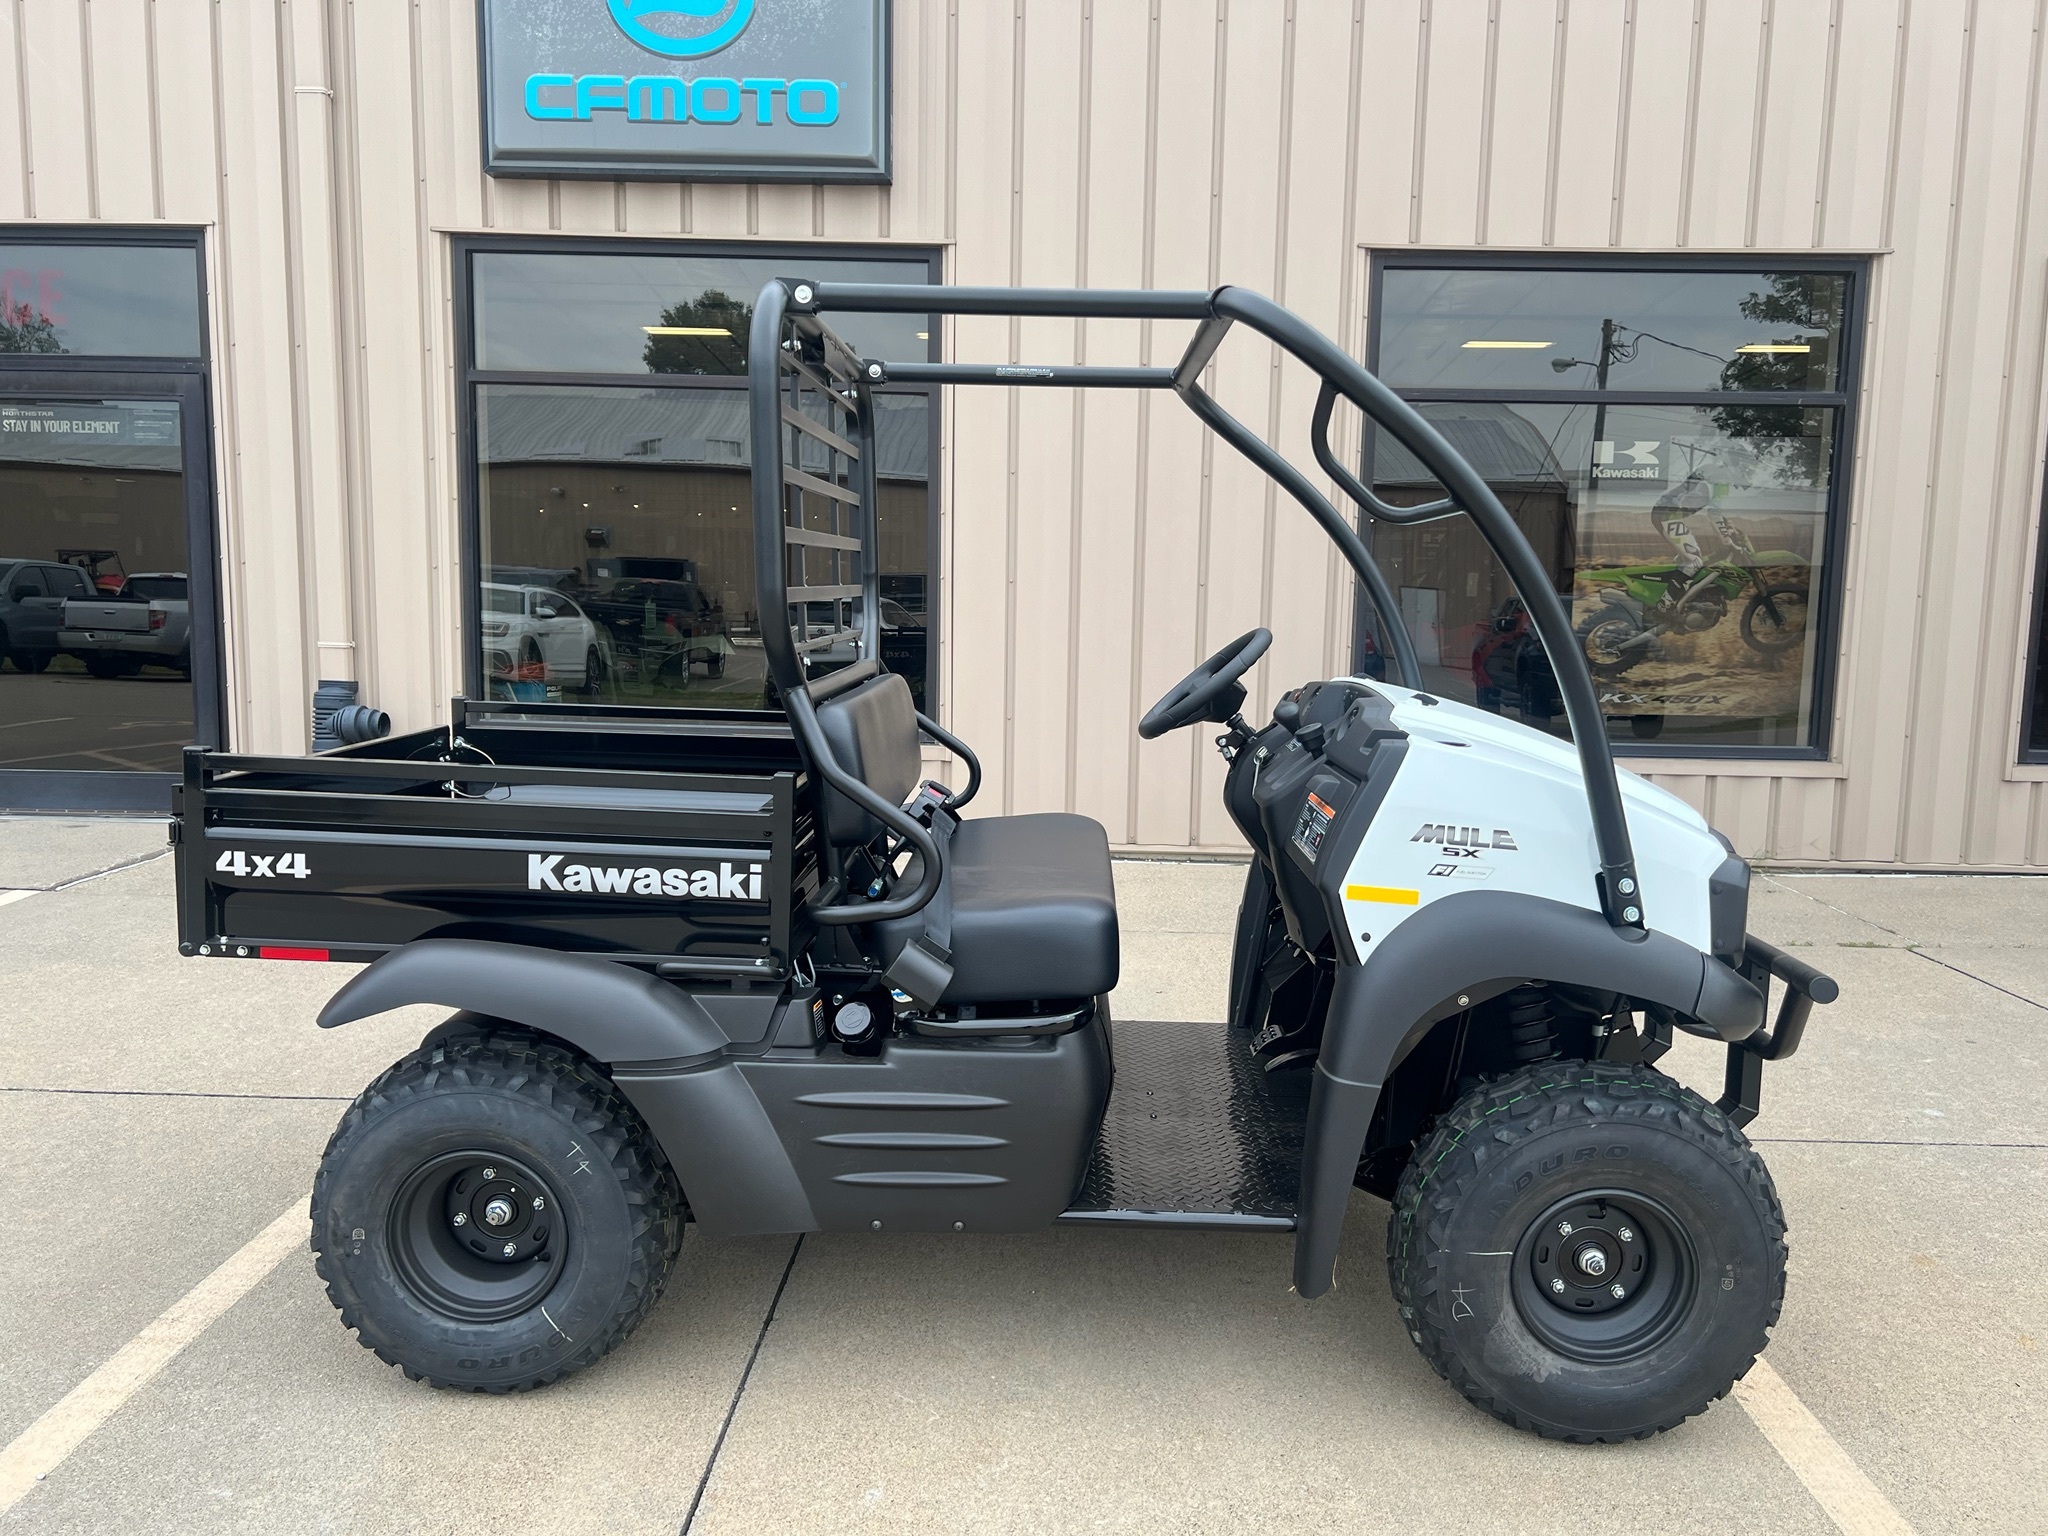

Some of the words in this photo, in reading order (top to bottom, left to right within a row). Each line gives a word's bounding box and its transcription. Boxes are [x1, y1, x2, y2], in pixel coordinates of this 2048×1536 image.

[525, 73, 838, 124] CFMOTO
[3, 419, 30, 433] STAY
[31, 420, 41, 433] IN
[43, 420, 71, 433] YOUR
[73, 421, 120, 434] ELEMENT
[1592, 466, 1659, 478] Kawasaki
[1409, 823, 1518, 851] MULE
[215, 850, 311, 879] 4x4
[1441, 846, 1480, 859] SX
[528, 853, 763, 900] Kawasaki
[1513, 1143, 1632, 1196] DURO
